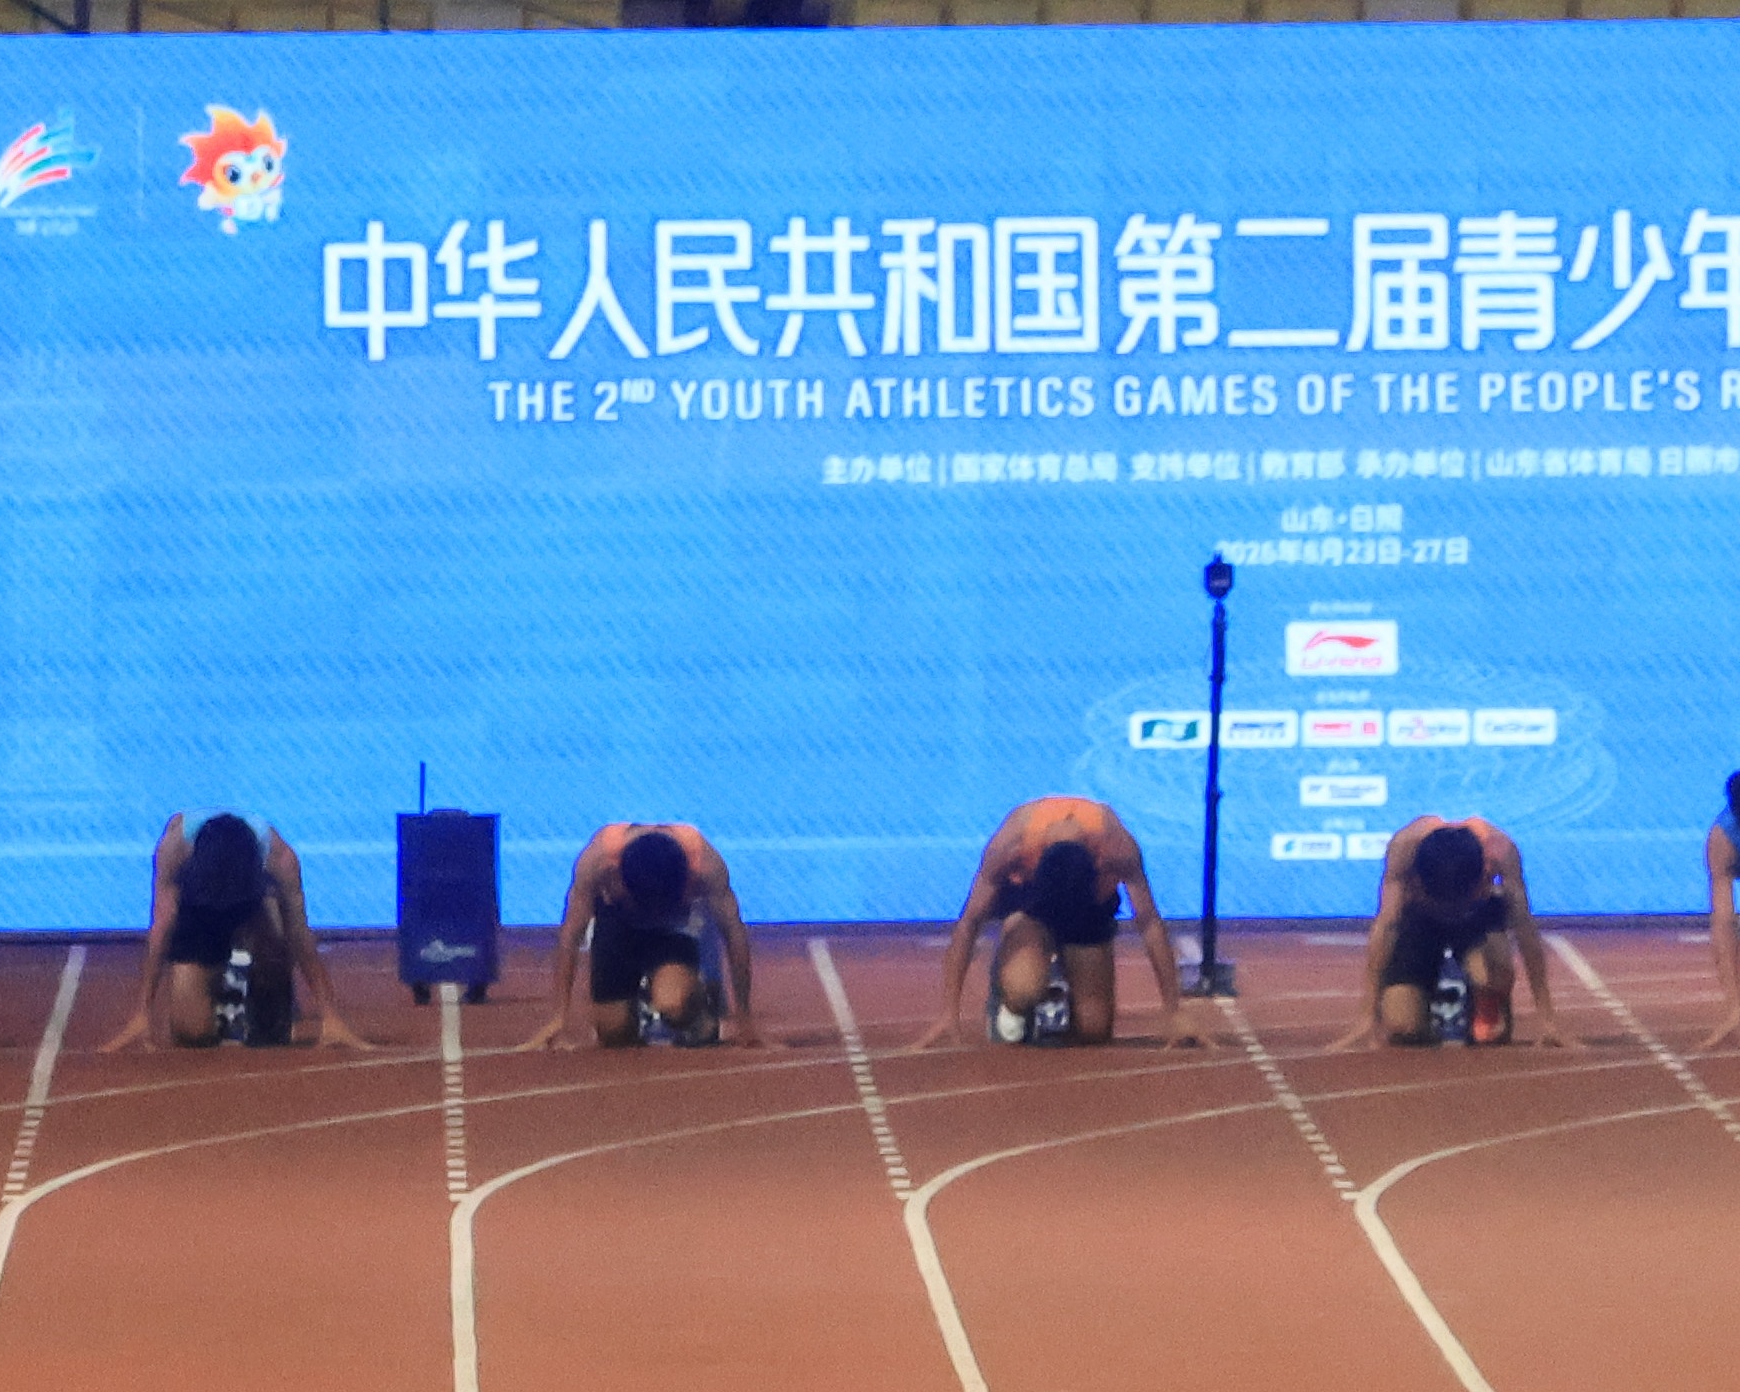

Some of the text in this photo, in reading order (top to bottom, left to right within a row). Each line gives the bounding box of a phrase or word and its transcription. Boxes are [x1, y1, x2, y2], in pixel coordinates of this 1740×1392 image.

[488, 382, 575, 423] THE
[671, 378, 825, 420] YOUTH
[844, 376, 1094, 418] ATHLETICS
[1113, 374, 1278, 416] GAMES
[1297, 373, 1355, 415] OF
[1372, 373, 1459, 414] THE
[1478, 370, 1701, 413] PEOPLE'S
